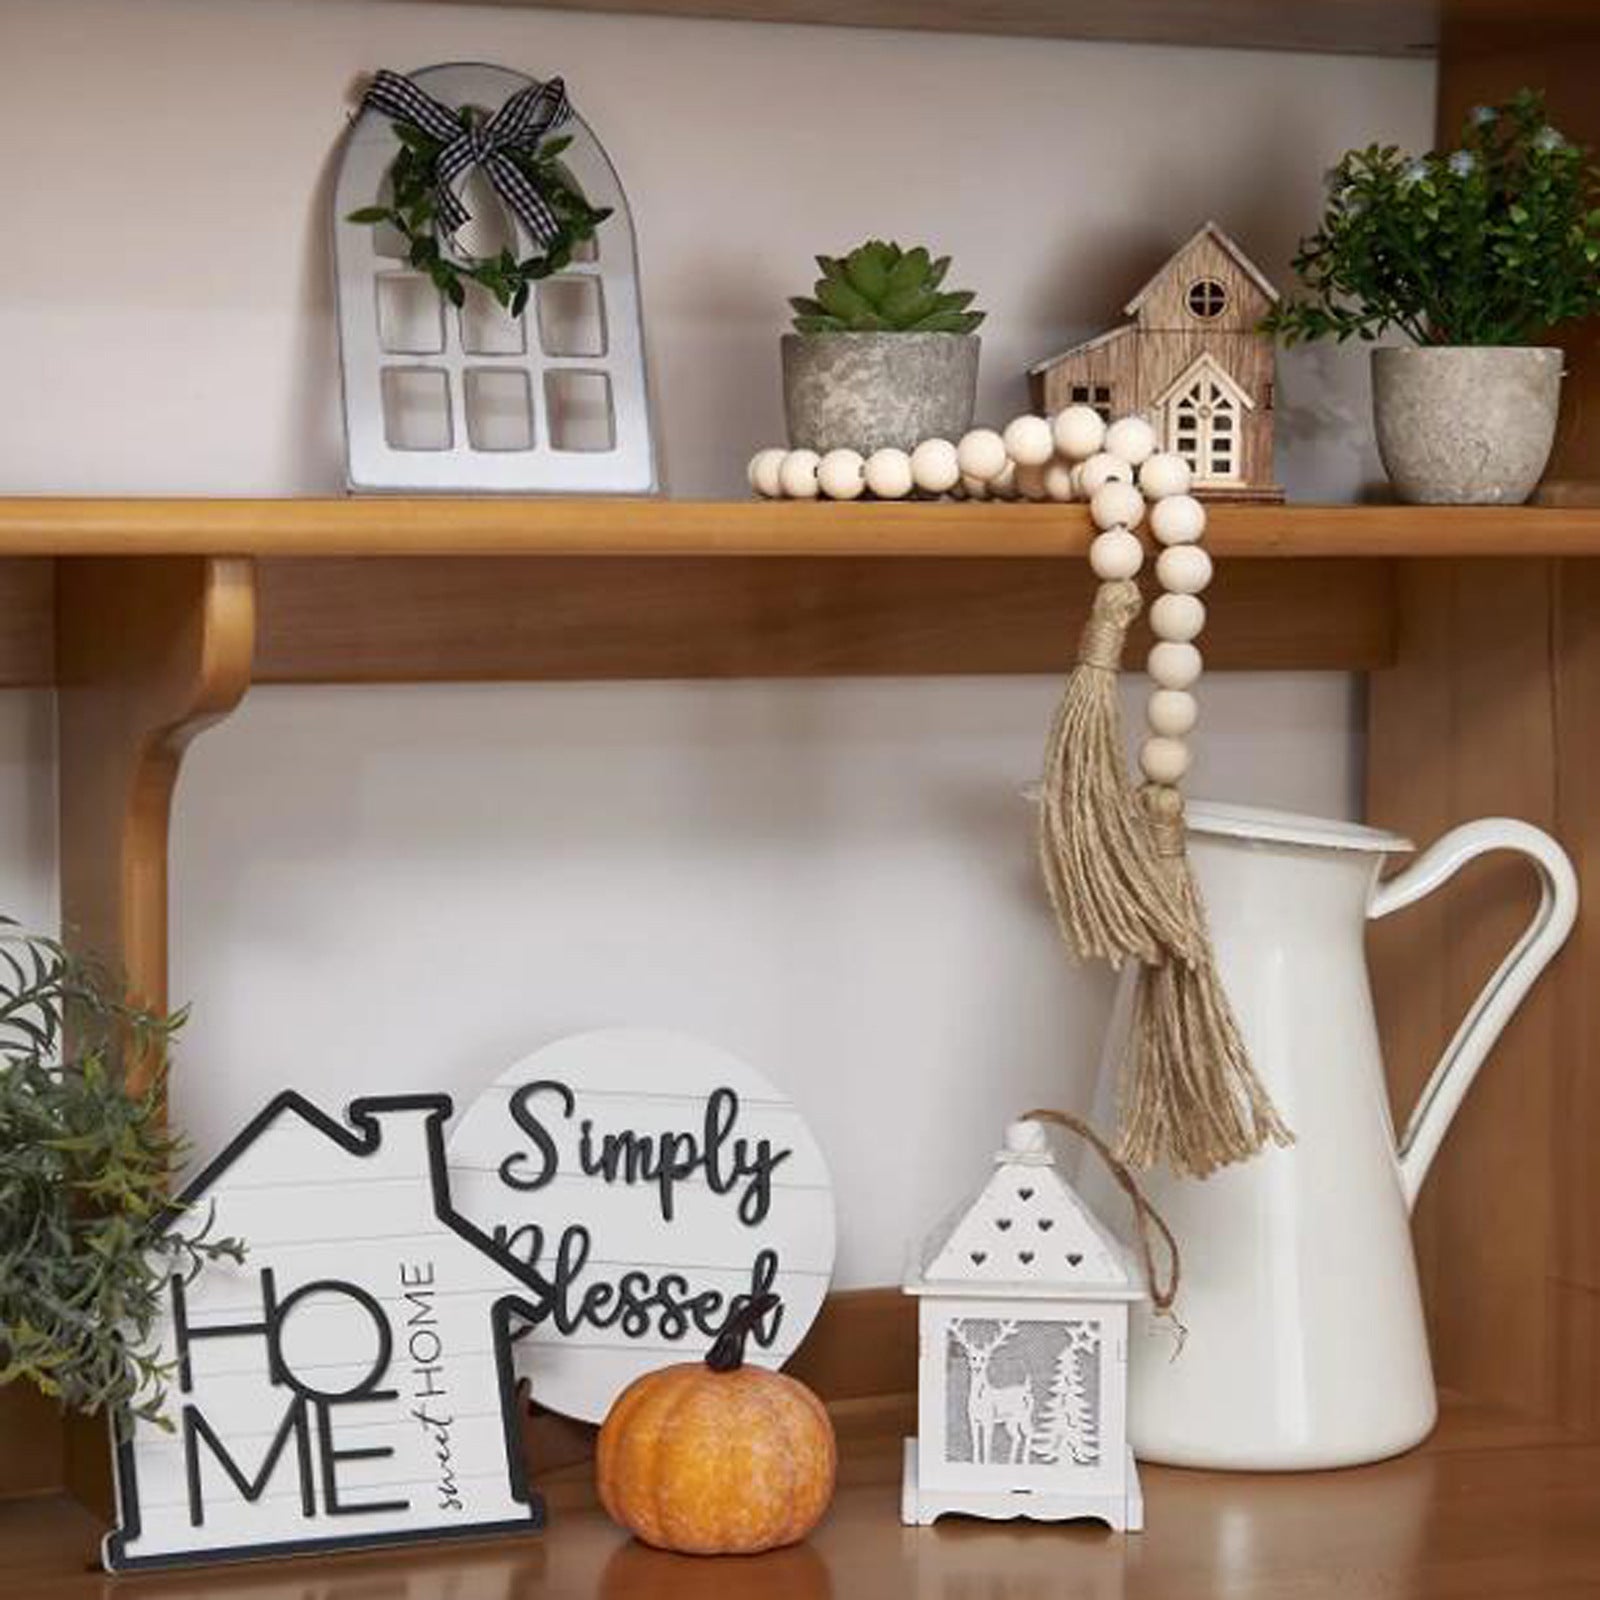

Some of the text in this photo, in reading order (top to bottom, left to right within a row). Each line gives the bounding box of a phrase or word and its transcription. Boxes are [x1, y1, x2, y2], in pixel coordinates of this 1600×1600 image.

[499, 1080, 792, 1226] Simply
[400, 1262, 463, 1510] sweet HOME
